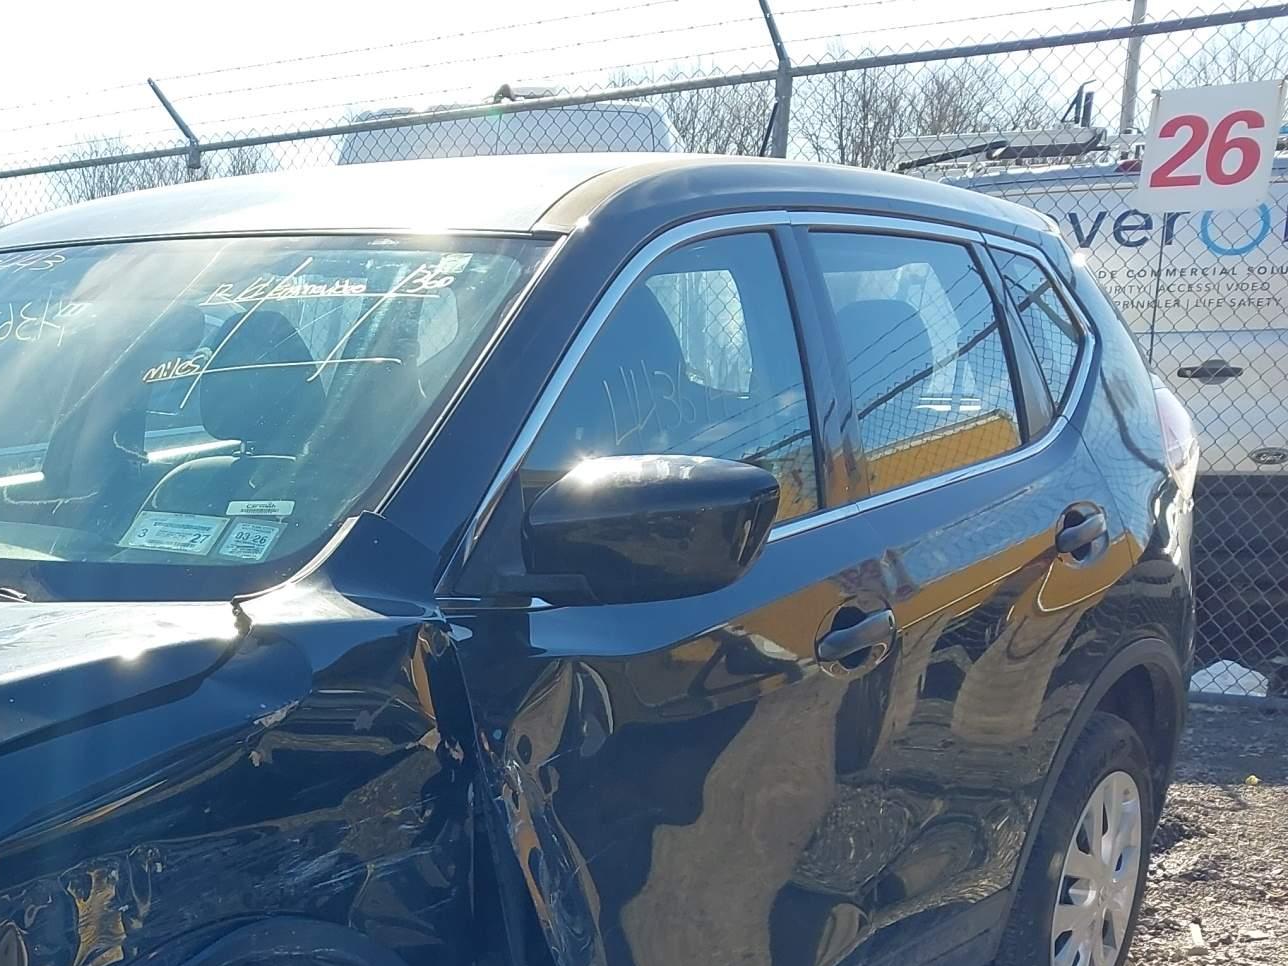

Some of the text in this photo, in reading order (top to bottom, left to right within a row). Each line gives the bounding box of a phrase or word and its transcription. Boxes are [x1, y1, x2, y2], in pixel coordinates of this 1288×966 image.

[1150, 110, 1265, 187] 26
[1126, 266, 1238, 279] COMMERCIAL
[1158, 282, 1212, 293] ACCESS
[1227, 281, 1271, 292] VIDEO
[1195, 298, 1225, 308] LIFE
[1229, 297, 1283, 308] SAFETY
[136, 528, 149, 538] 3
[190, 533, 211, 544] 27
[235, 531, 269, 544] 03 26
